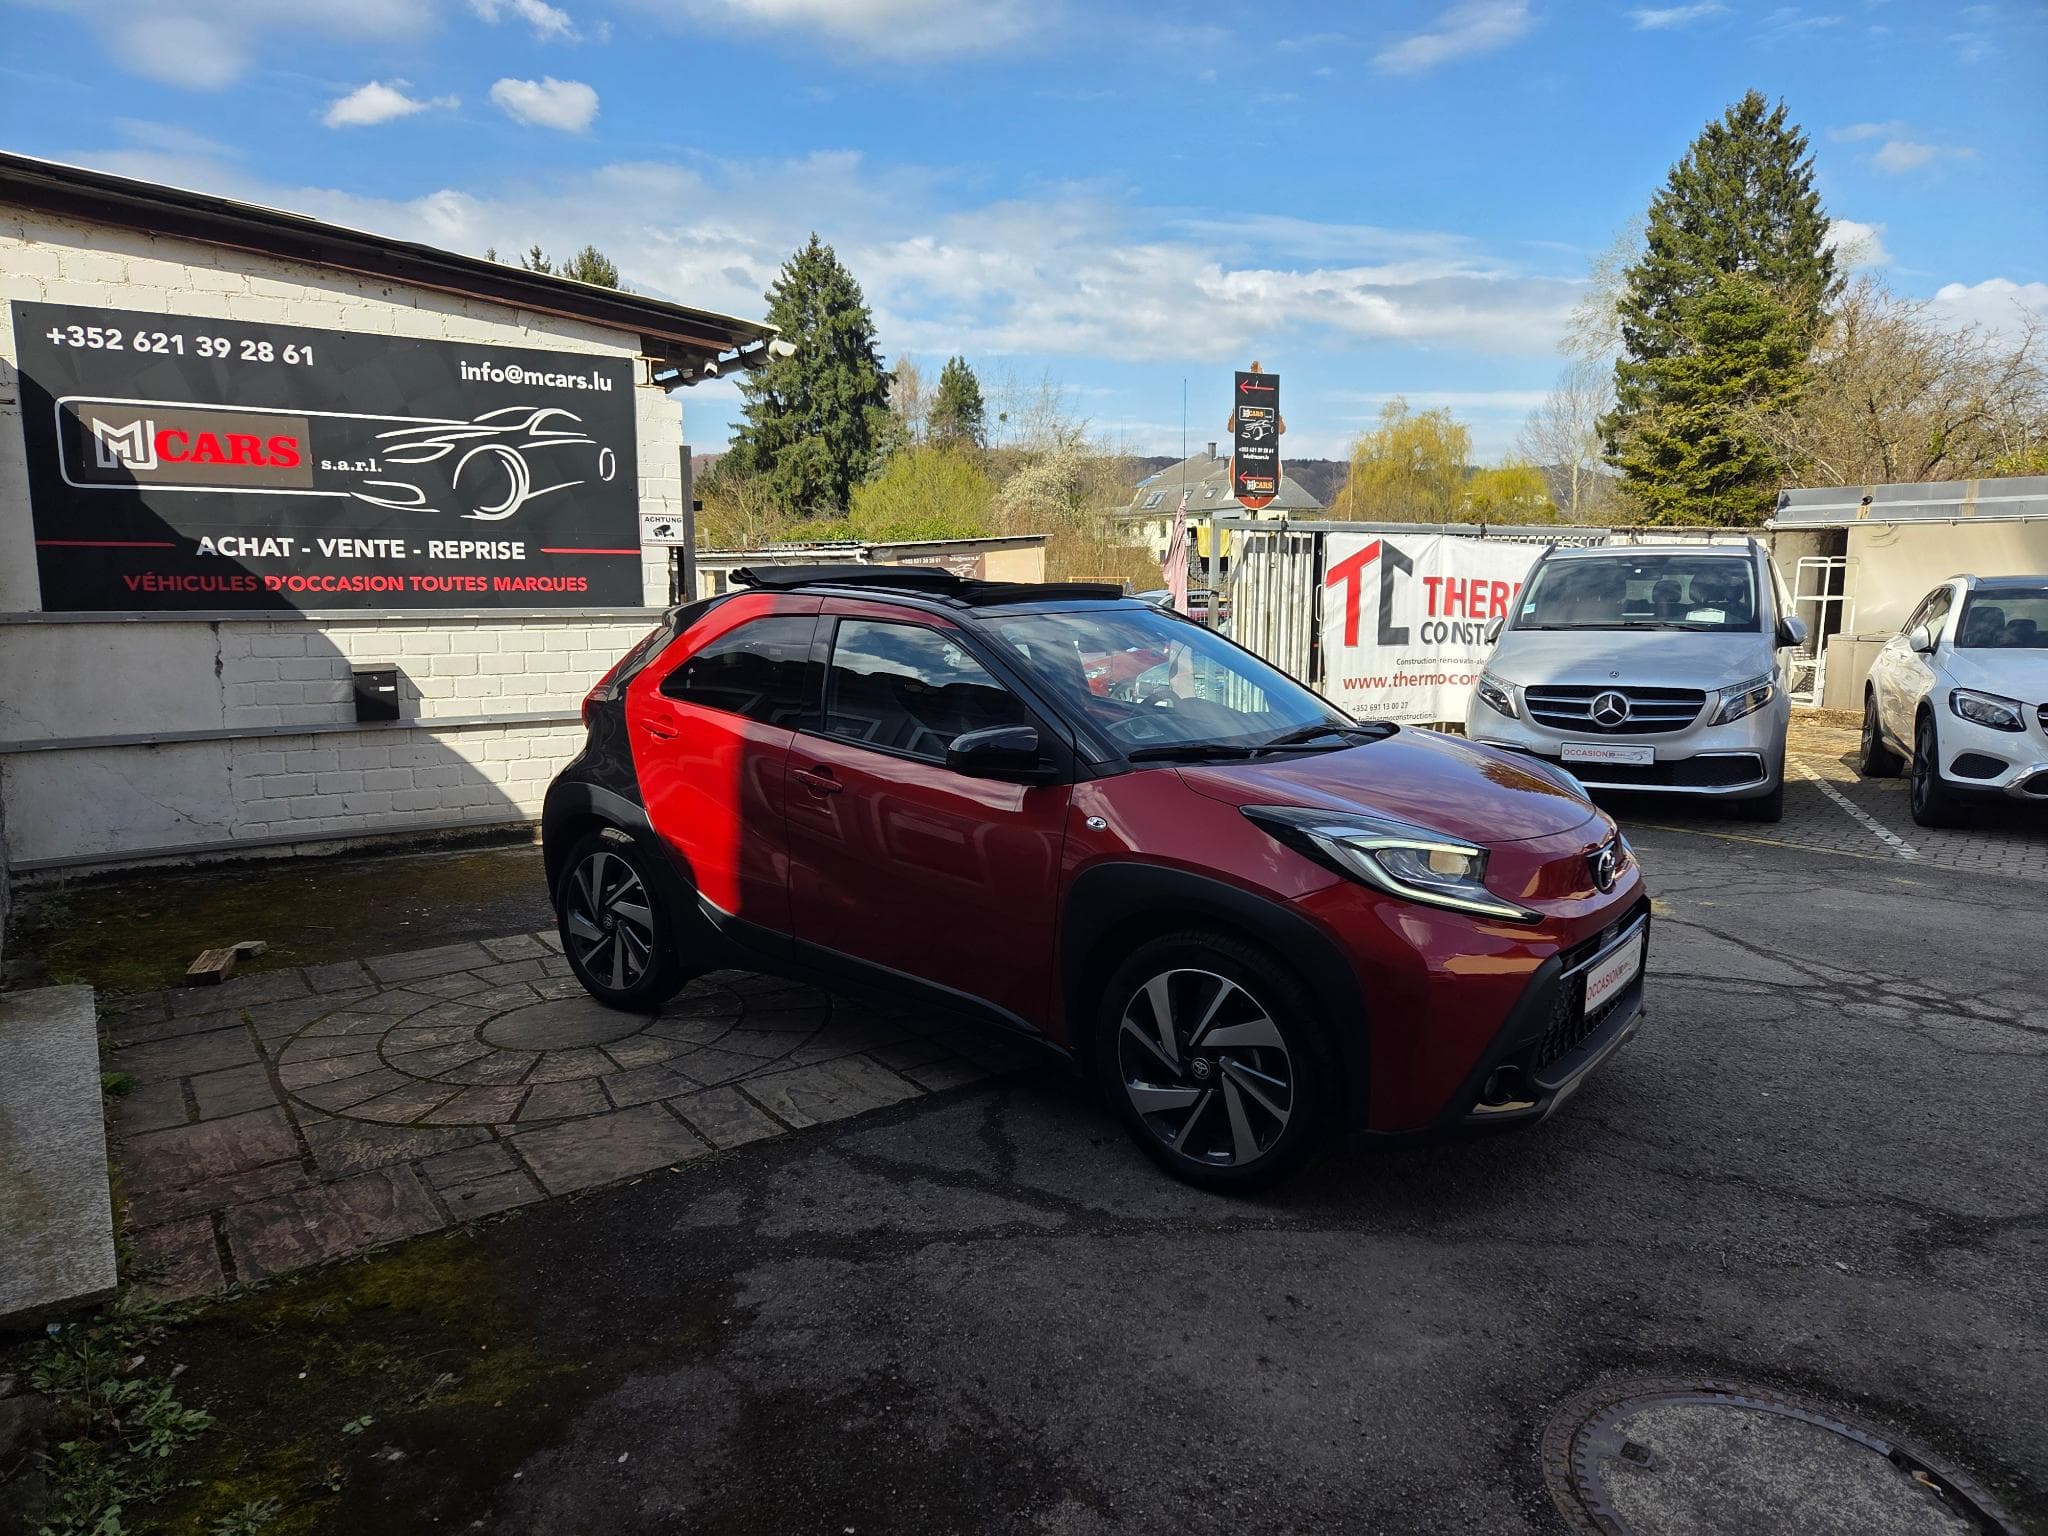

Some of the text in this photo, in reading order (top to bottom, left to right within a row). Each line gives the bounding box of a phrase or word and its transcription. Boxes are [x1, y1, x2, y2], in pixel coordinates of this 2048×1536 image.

[46, 325, 314, 366] +352 621 39 28 61
[460, 361, 613, 392] info@mcars.lu
[154, 429, 301, 468] CARS
[321, 458, 382, 472] s.a.r.l.
[196, 536, 294, 557] ACHAT
[317, 538, 406, 559] VENTE
[428, 540, 526, 560] REPRISE
[123, 571, 588, 592] VÉHICULES D'OCCASION TOUTES MARQUES
[1420, 621, 1495, 645] CONST
[1563, 749, 1608, 758] OCCASION
[1586, 968, 1620, 1000] OCCASION
